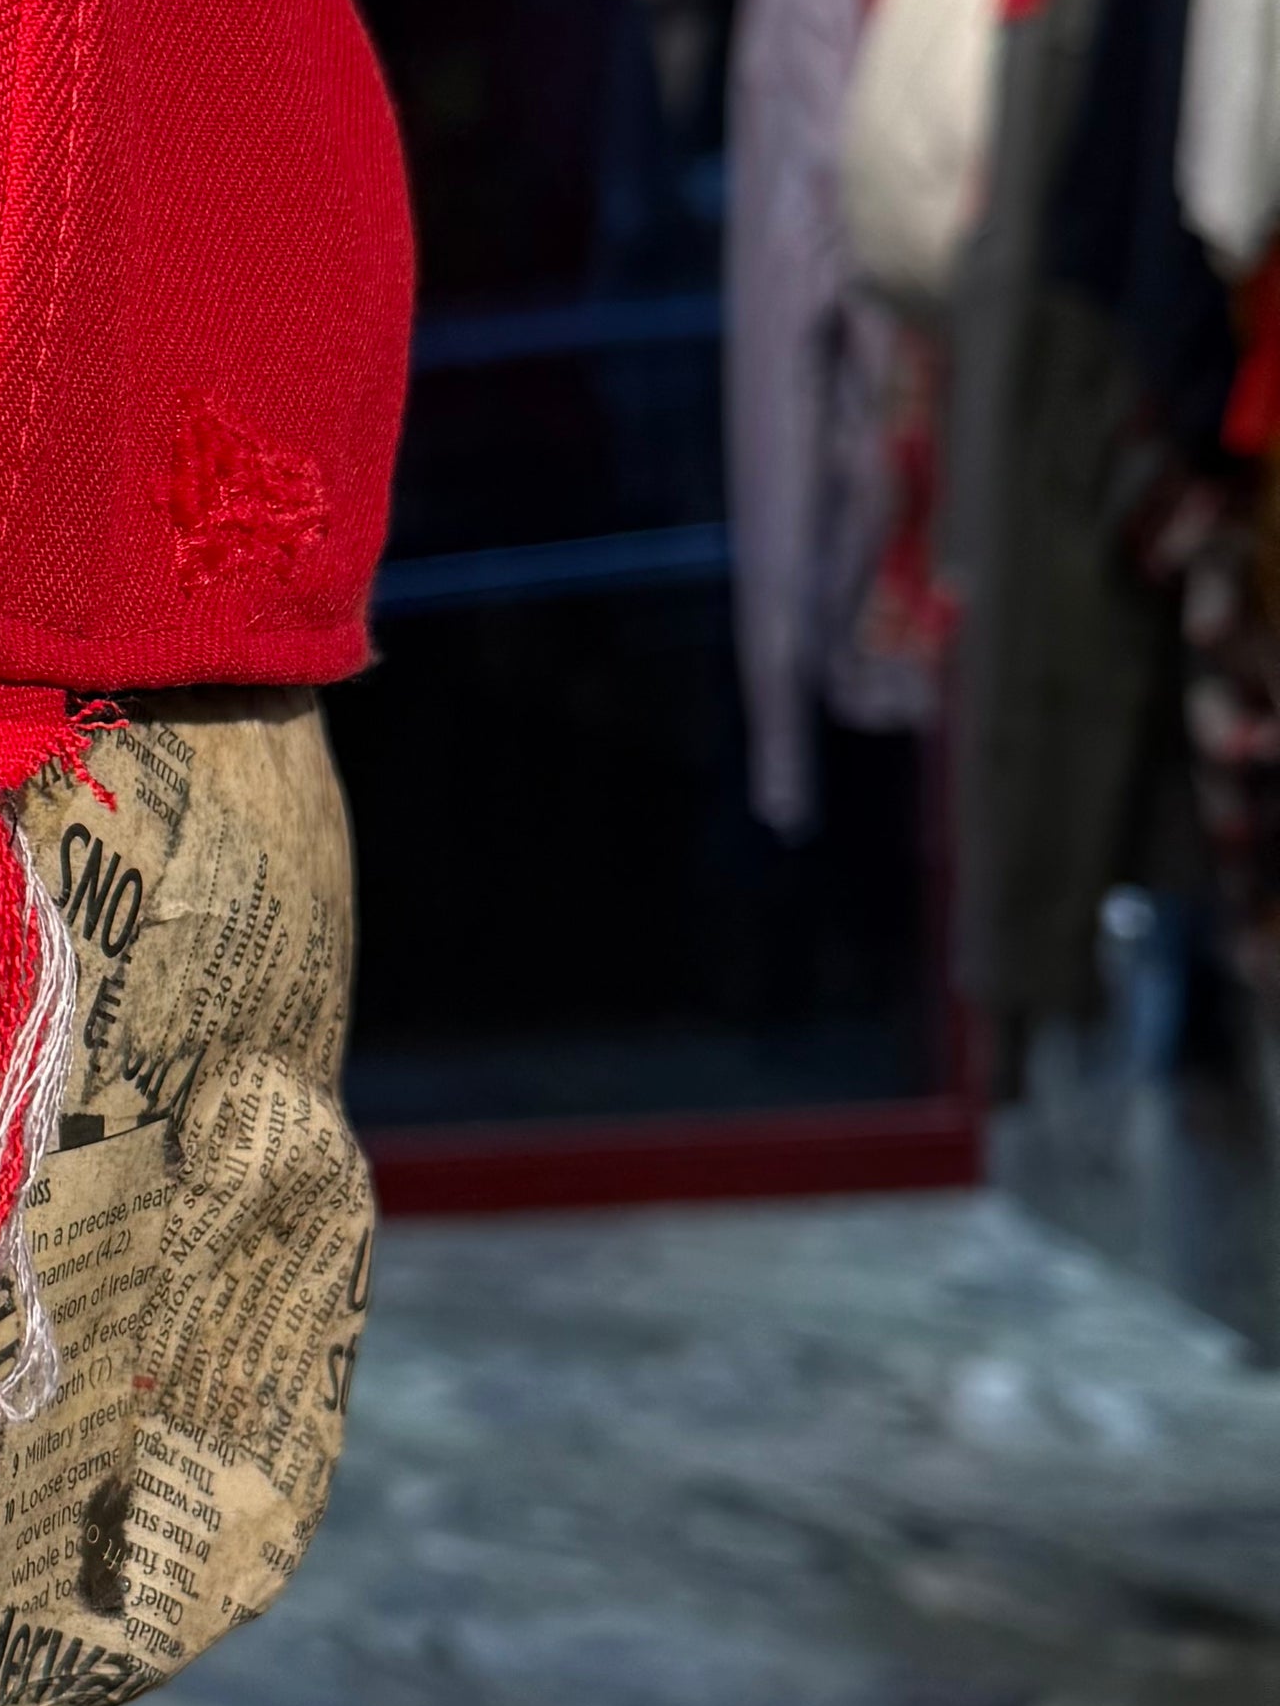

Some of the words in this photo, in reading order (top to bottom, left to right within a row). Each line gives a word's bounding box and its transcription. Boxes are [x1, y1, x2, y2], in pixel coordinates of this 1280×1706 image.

[203, 898, 240, 980] home
[212, 977, 233, 1011] 20
[229, 850, 270, 969] minutes
[228, 895, 282, 1020] deciding
[246, 922, 289, 1018] survey
[259, 1089, 288, 1181] ensure
[32, 1229, 49, 1255] In
[53, 1225, 64, 1244] a
[68, 1200, 130, 1243] precise,
[241, 1170, 312, 1260] fascism
[310, 1126, 333, 1158] in
[241, 1213, 327, 1379] communism
[25, 1424, 74, 1470] Military
[11, 1547, 61, 1588] whole
[16, 1499, 84, 1551] covering
[130, 1581, 185, 1628] Chief
